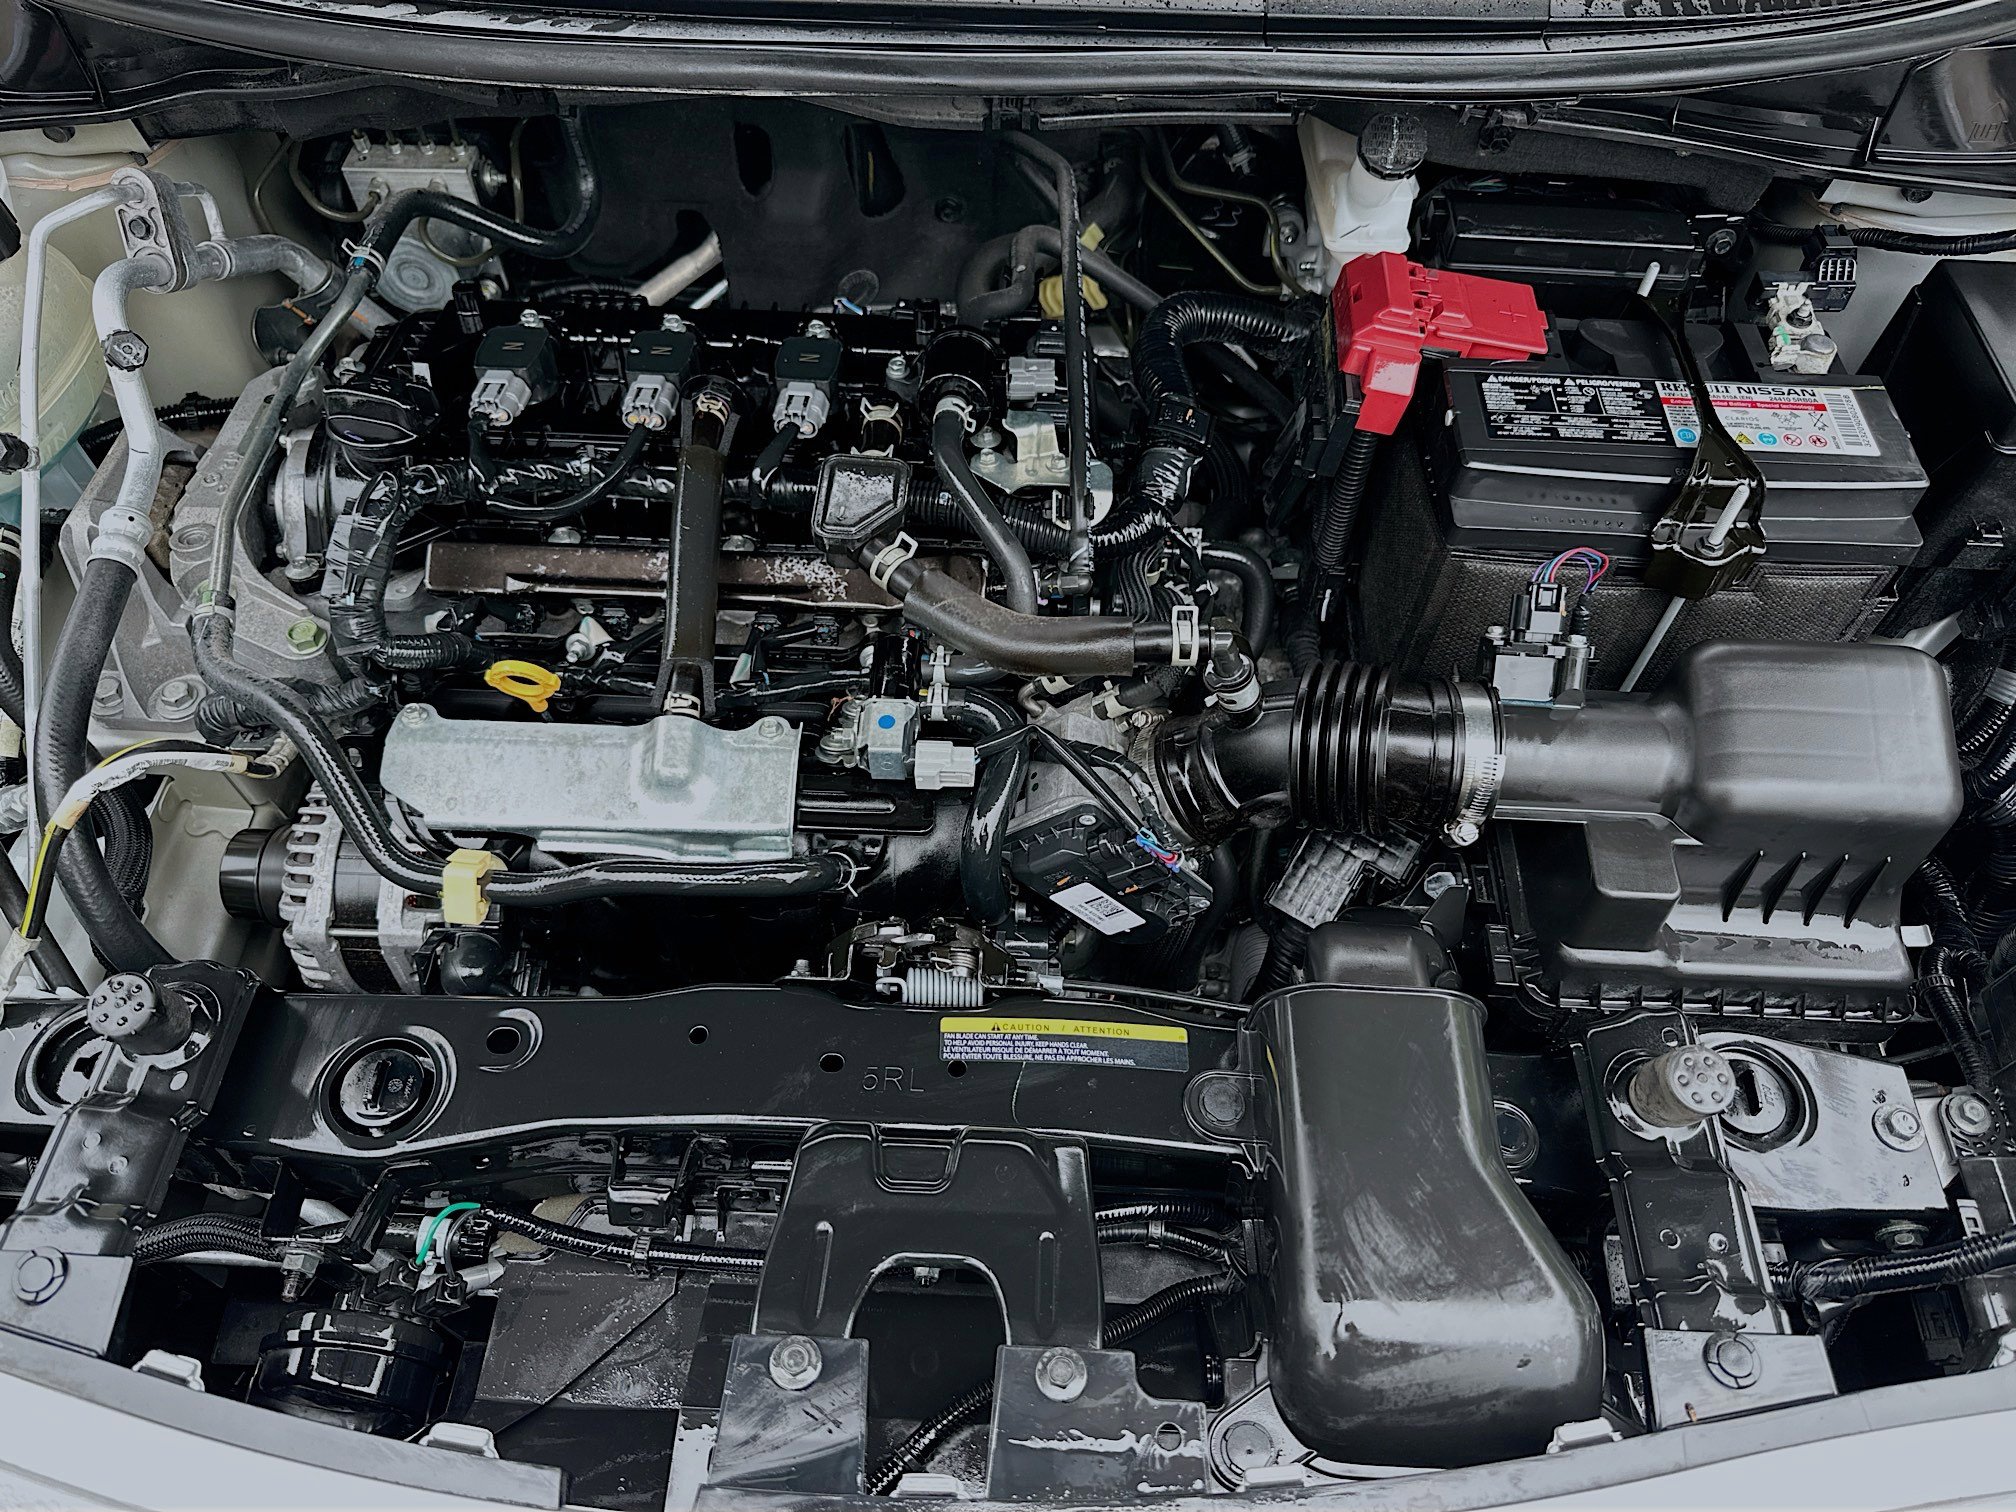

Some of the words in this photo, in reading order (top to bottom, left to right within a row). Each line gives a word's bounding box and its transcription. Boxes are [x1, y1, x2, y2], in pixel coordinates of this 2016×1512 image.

[1736, 386, 1816, 397] NISSAN
[1002, 1023, 1050, 1031] CAUTION
[1073, 1026, 1130, 1036] ATTENTION
[1080, 1049, 1109, 1057] MOMENT.
[862, 1066, 925, 1092] 5RL
